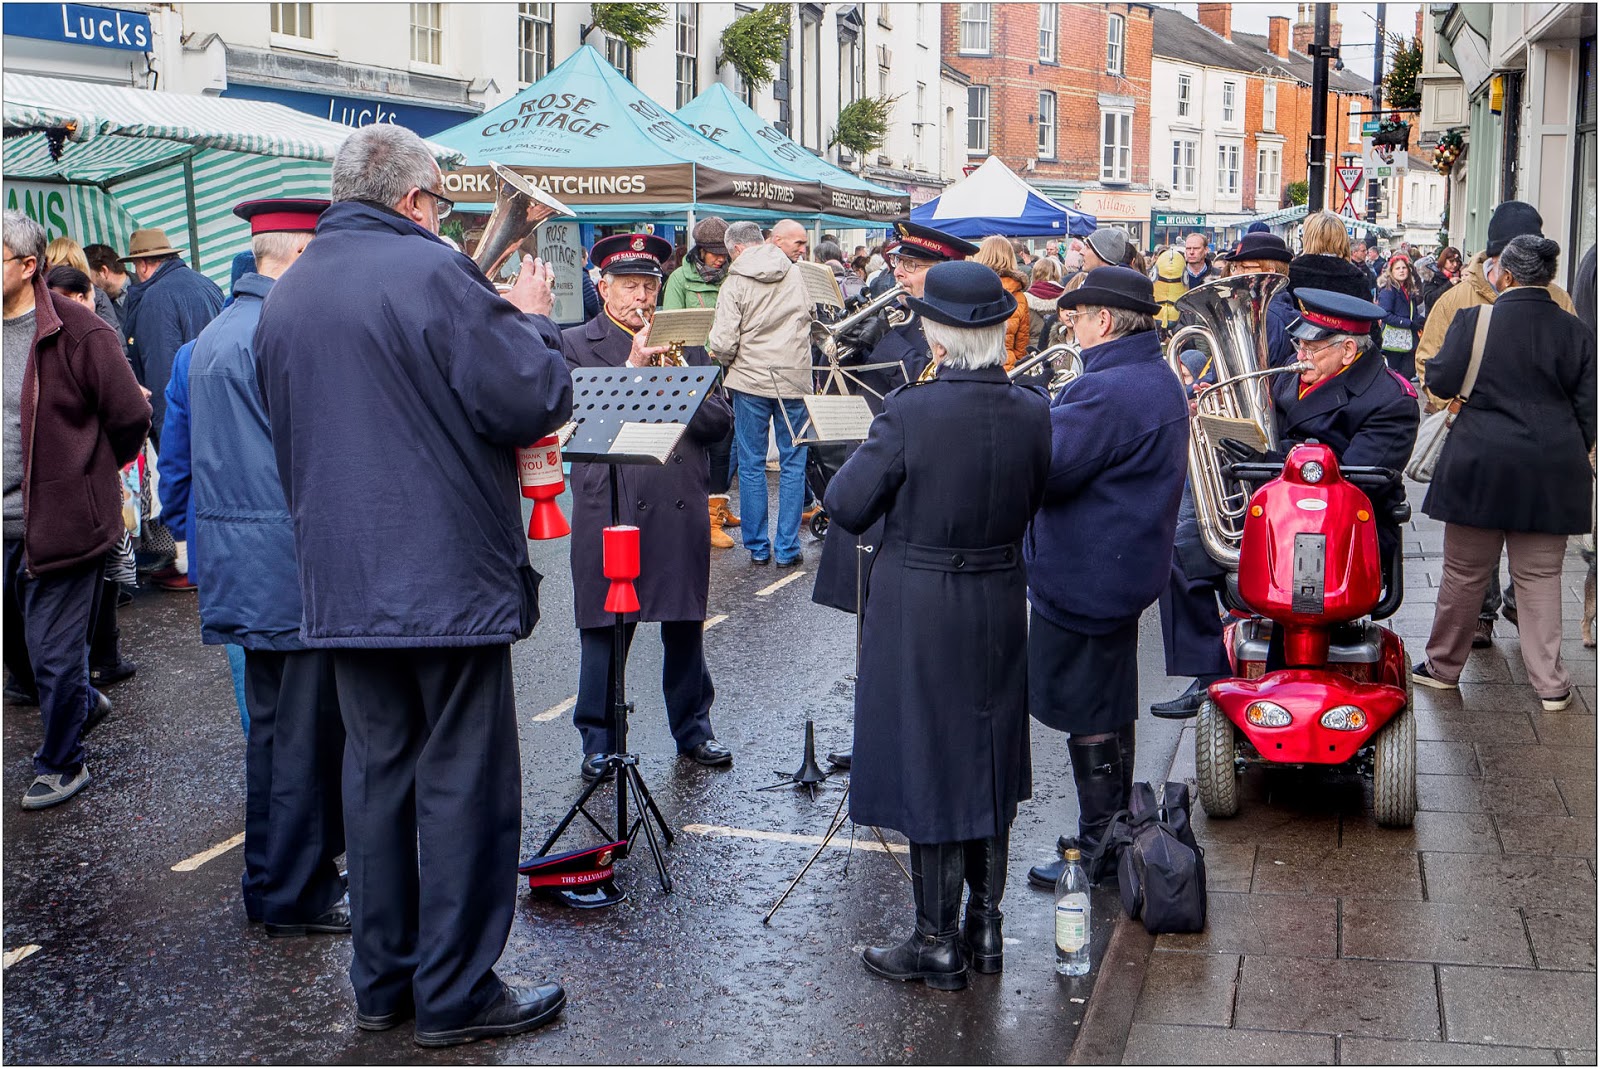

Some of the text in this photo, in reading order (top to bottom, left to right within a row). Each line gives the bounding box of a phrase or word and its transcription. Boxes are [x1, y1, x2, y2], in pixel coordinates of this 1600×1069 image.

[62, 4, 147, 47] Lucks
[329, 98, 397, 128] Lucks
[518, 93, 597, 115] ROSE
[628, 99, 660, 121] RO
[481, 111, 610, 138] COTTAGE
[508, 129, 570, 139] PANTRY
[756, 126, 783, 144] RO
[479, 146, 501, 154] PIES
[515, 142, 571, 154] PASTRIES
[522, 174, 646, 194] RATCHINGS
[732, 181, 795, 203] PIES & PASTRIES
[832, 191, 902, 216] FRESH PORK SCRATCHINGS
[1095, 195, 1136, 215] Milano's
[546, 225, 568, 243] ROSE
[922, 240, 943, 251] ARMY
[540, 244, 576, 268] COTTAGE
[610, 254, 620, 263] THE
[620, 252, 652, 260] SALVATION
[1321, 316, 1343, 326] ARMY
[521, 453, 542, 461] THANK
[521, 461, 543, 470] YOU
[561, 868, 611, 884] THE SALVATION
